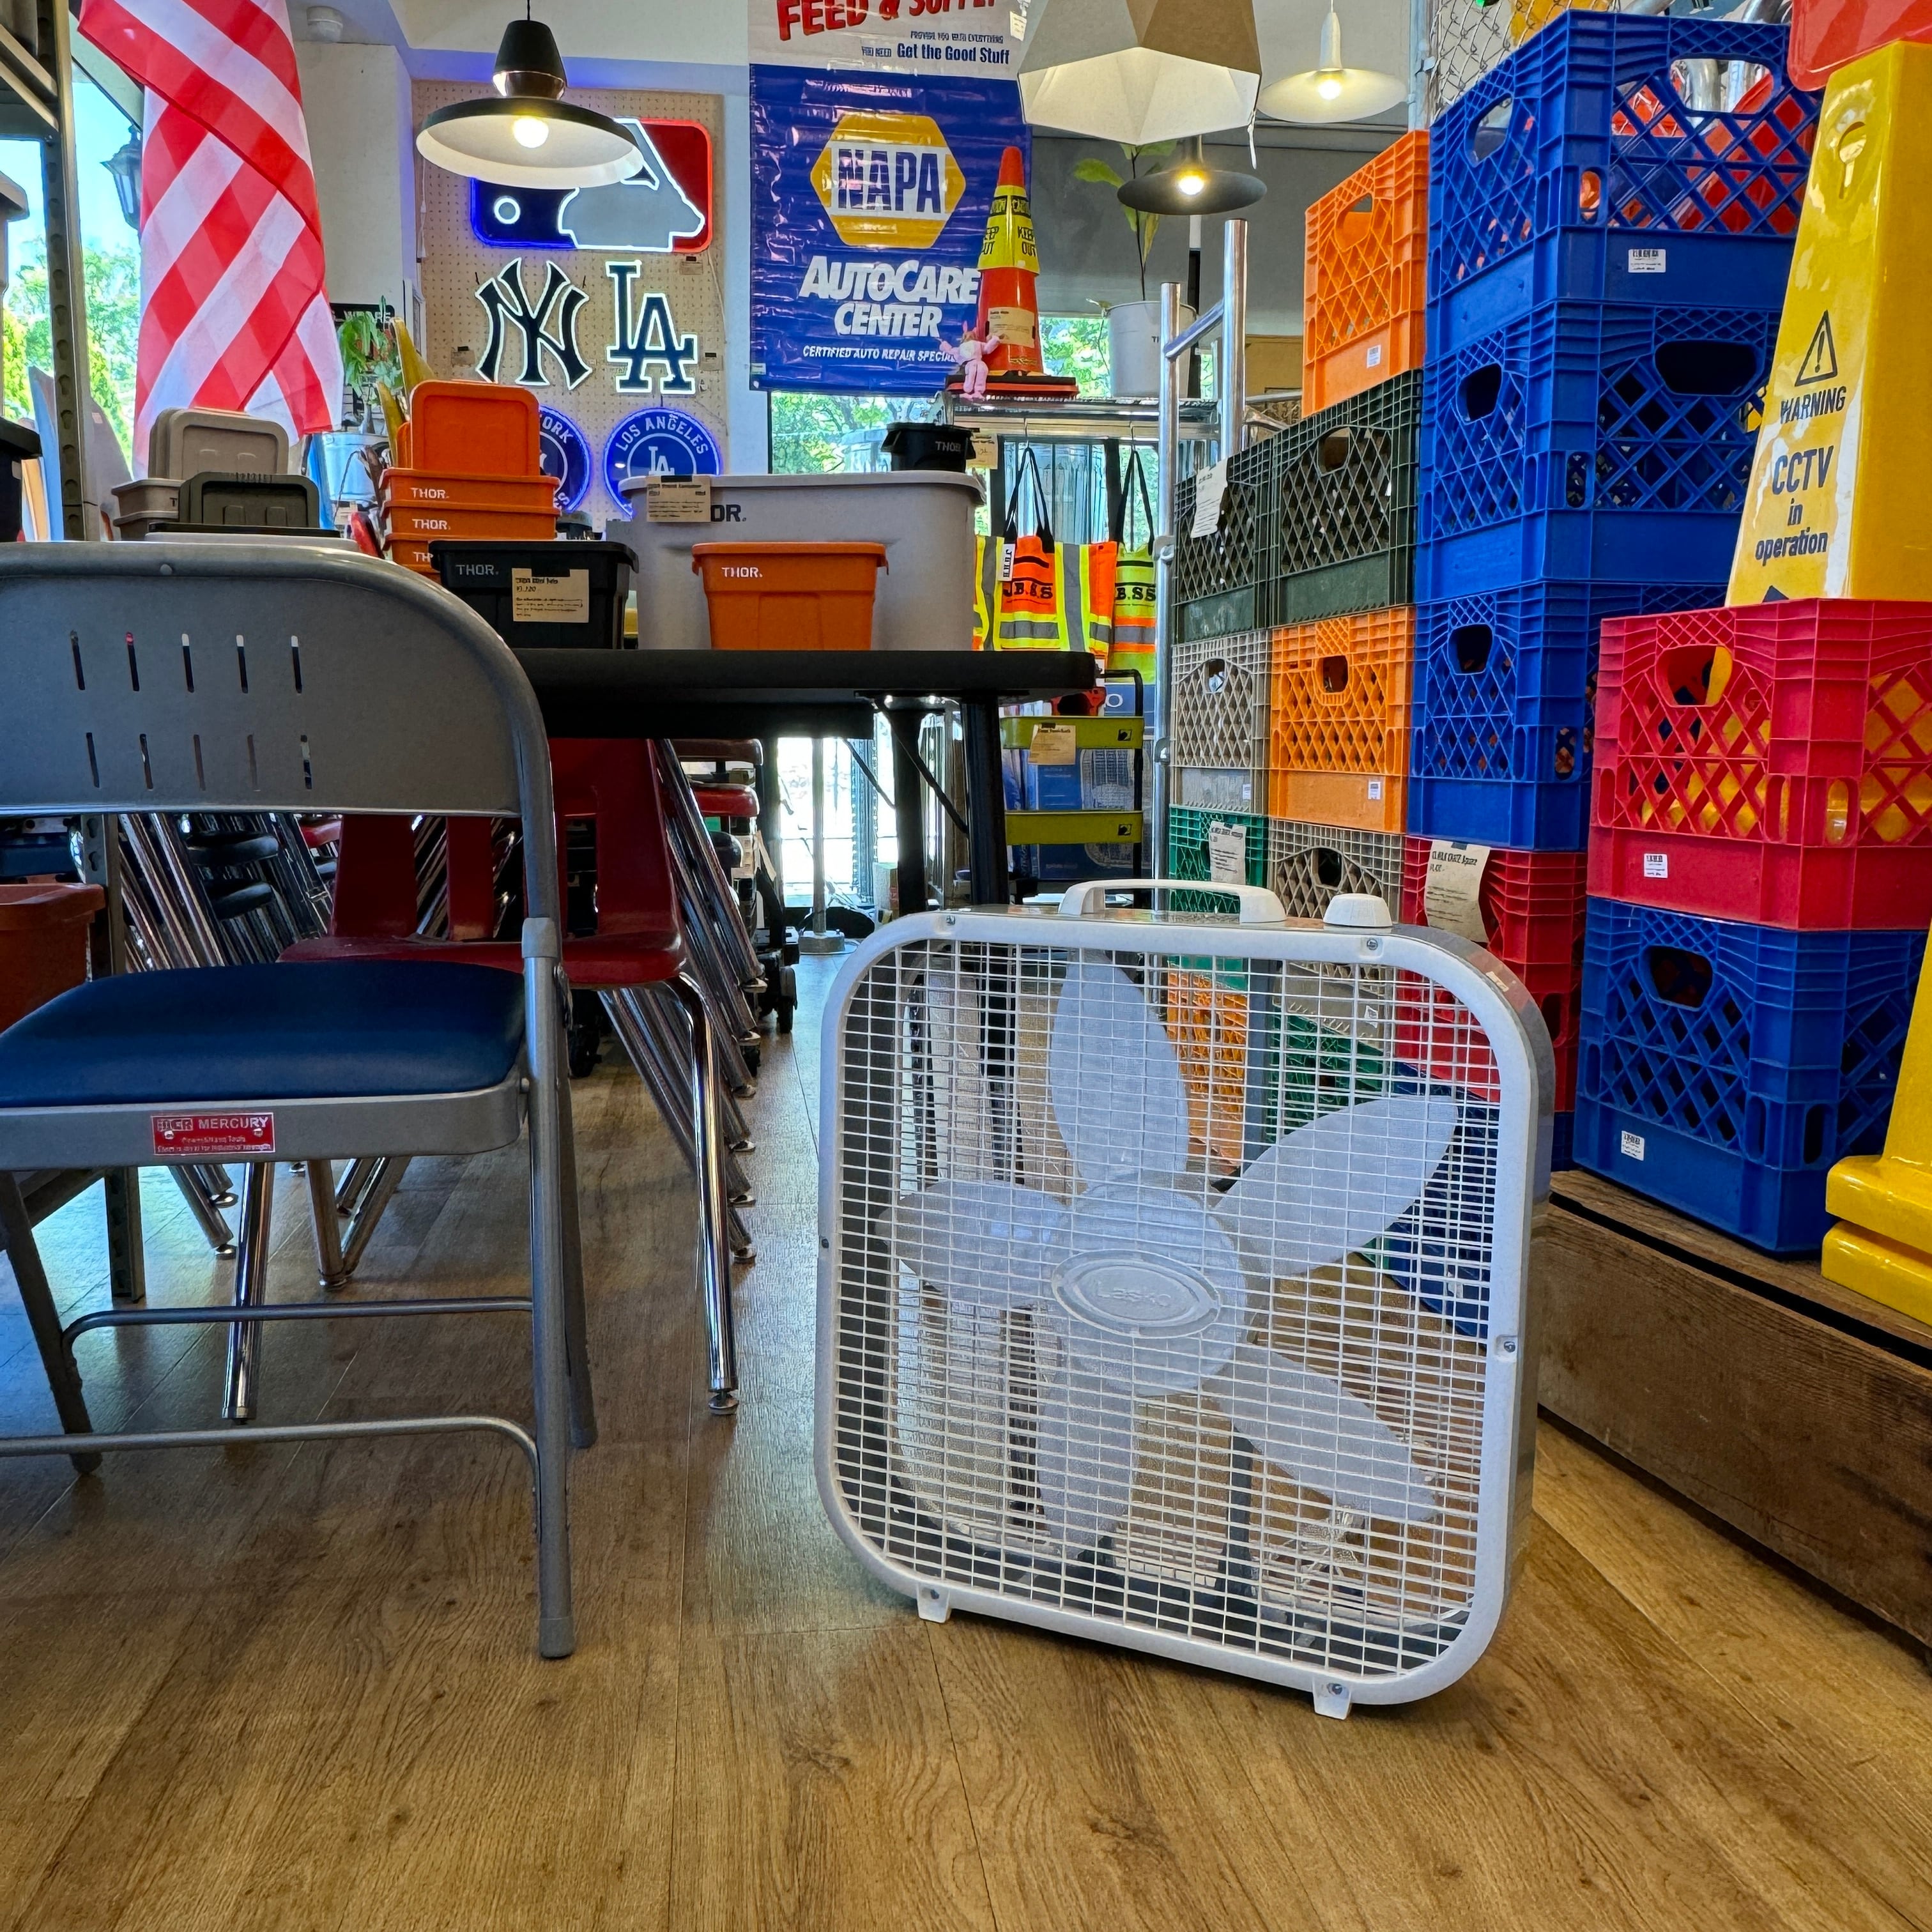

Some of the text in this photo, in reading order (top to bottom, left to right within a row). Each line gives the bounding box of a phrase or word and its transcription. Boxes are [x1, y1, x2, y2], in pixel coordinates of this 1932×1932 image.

[777, 0, 869, 41] FEED
[897, 43, 918, 59] Get
[921, 44, 942, 60] the
[945, 45, 976, 62] Good
[979, 47, 1009, 65] Stuff
[838, 148, 942, 213] NAPA
[475, 257, 593, 390] NY
[605, 259, 698, 395] LA
[834, 302, 943, 337] CENTER
[803, 345, 852, 358] CERTIFIED
[853, 348, 880, 359] AUTO
[882, 349, 916, 362] REPAIR
[1780, 386, 1847, 425] WARNING
[542, 416, 574, 444] ORK
[615, 416, 709, 454] LOS ANGELES
[648, 446, 675, 475] LA
[1772, 444, 1834, 496] CCTV
[710, 504, 747, 523] OR.
[1787, 498, 1804, 526] in
[1754, 526, 1828, 566] operation
[198, 1117, 268, 1130] MERCURY
